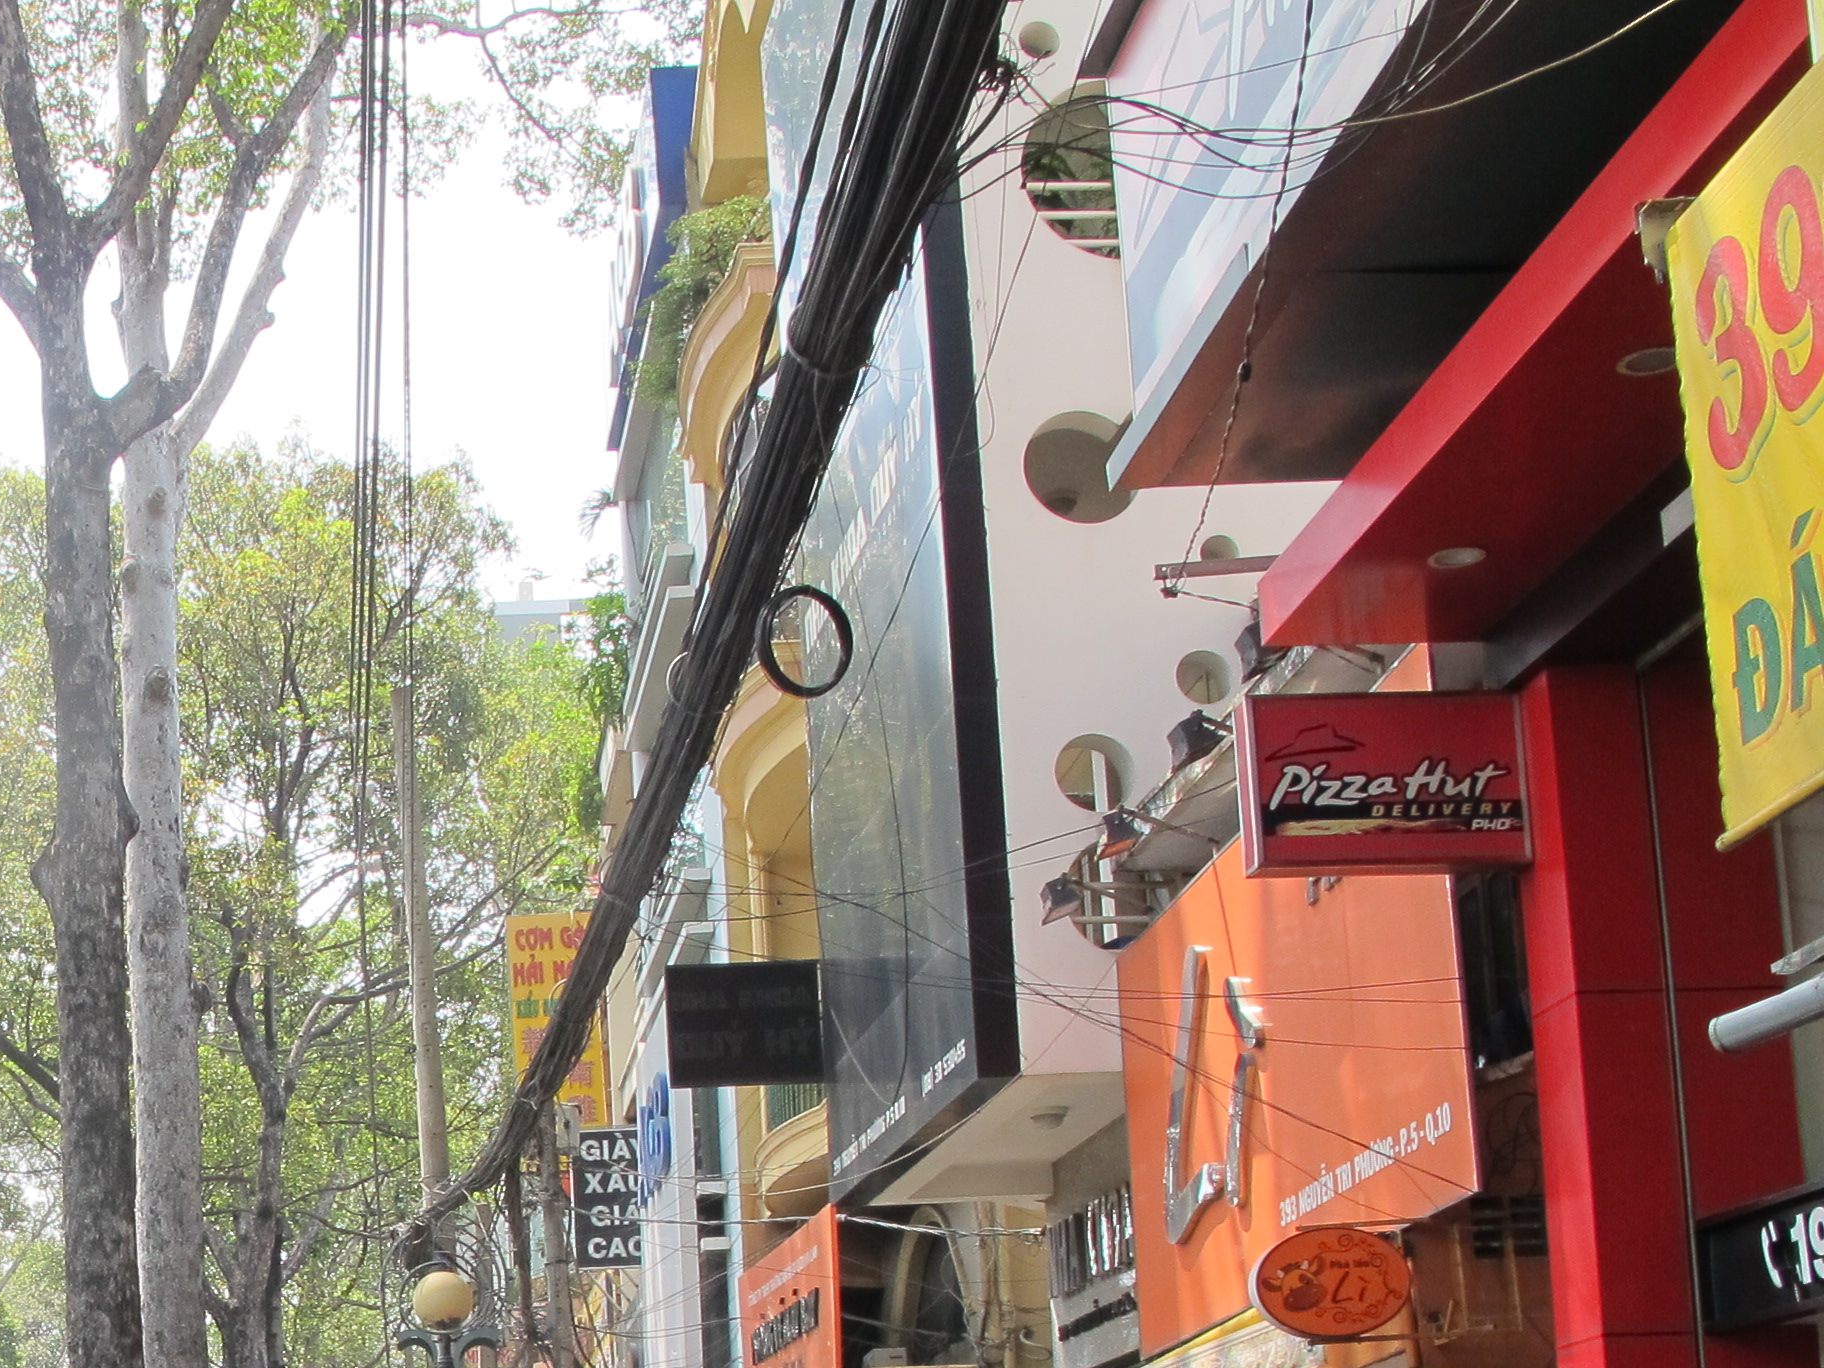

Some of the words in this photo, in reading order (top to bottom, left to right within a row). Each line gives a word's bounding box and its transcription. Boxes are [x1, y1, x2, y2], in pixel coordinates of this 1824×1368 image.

[1695, 164, 1824, 471] 39
[1269, 764, 1398, 811] Pizza
[1404, 760, 1510, 800] Hut
[1372, 802, 1512, 816] DELIVERY
[515, 926, 553, 951] CƠM
[513, 953, 544, 987] HẢI
[1279, 1195, 1297, 1227] 393
[1298, 1161, 1335, 1216] NGUYỄN
[1335, 1162, 1352, 1193] TRI
